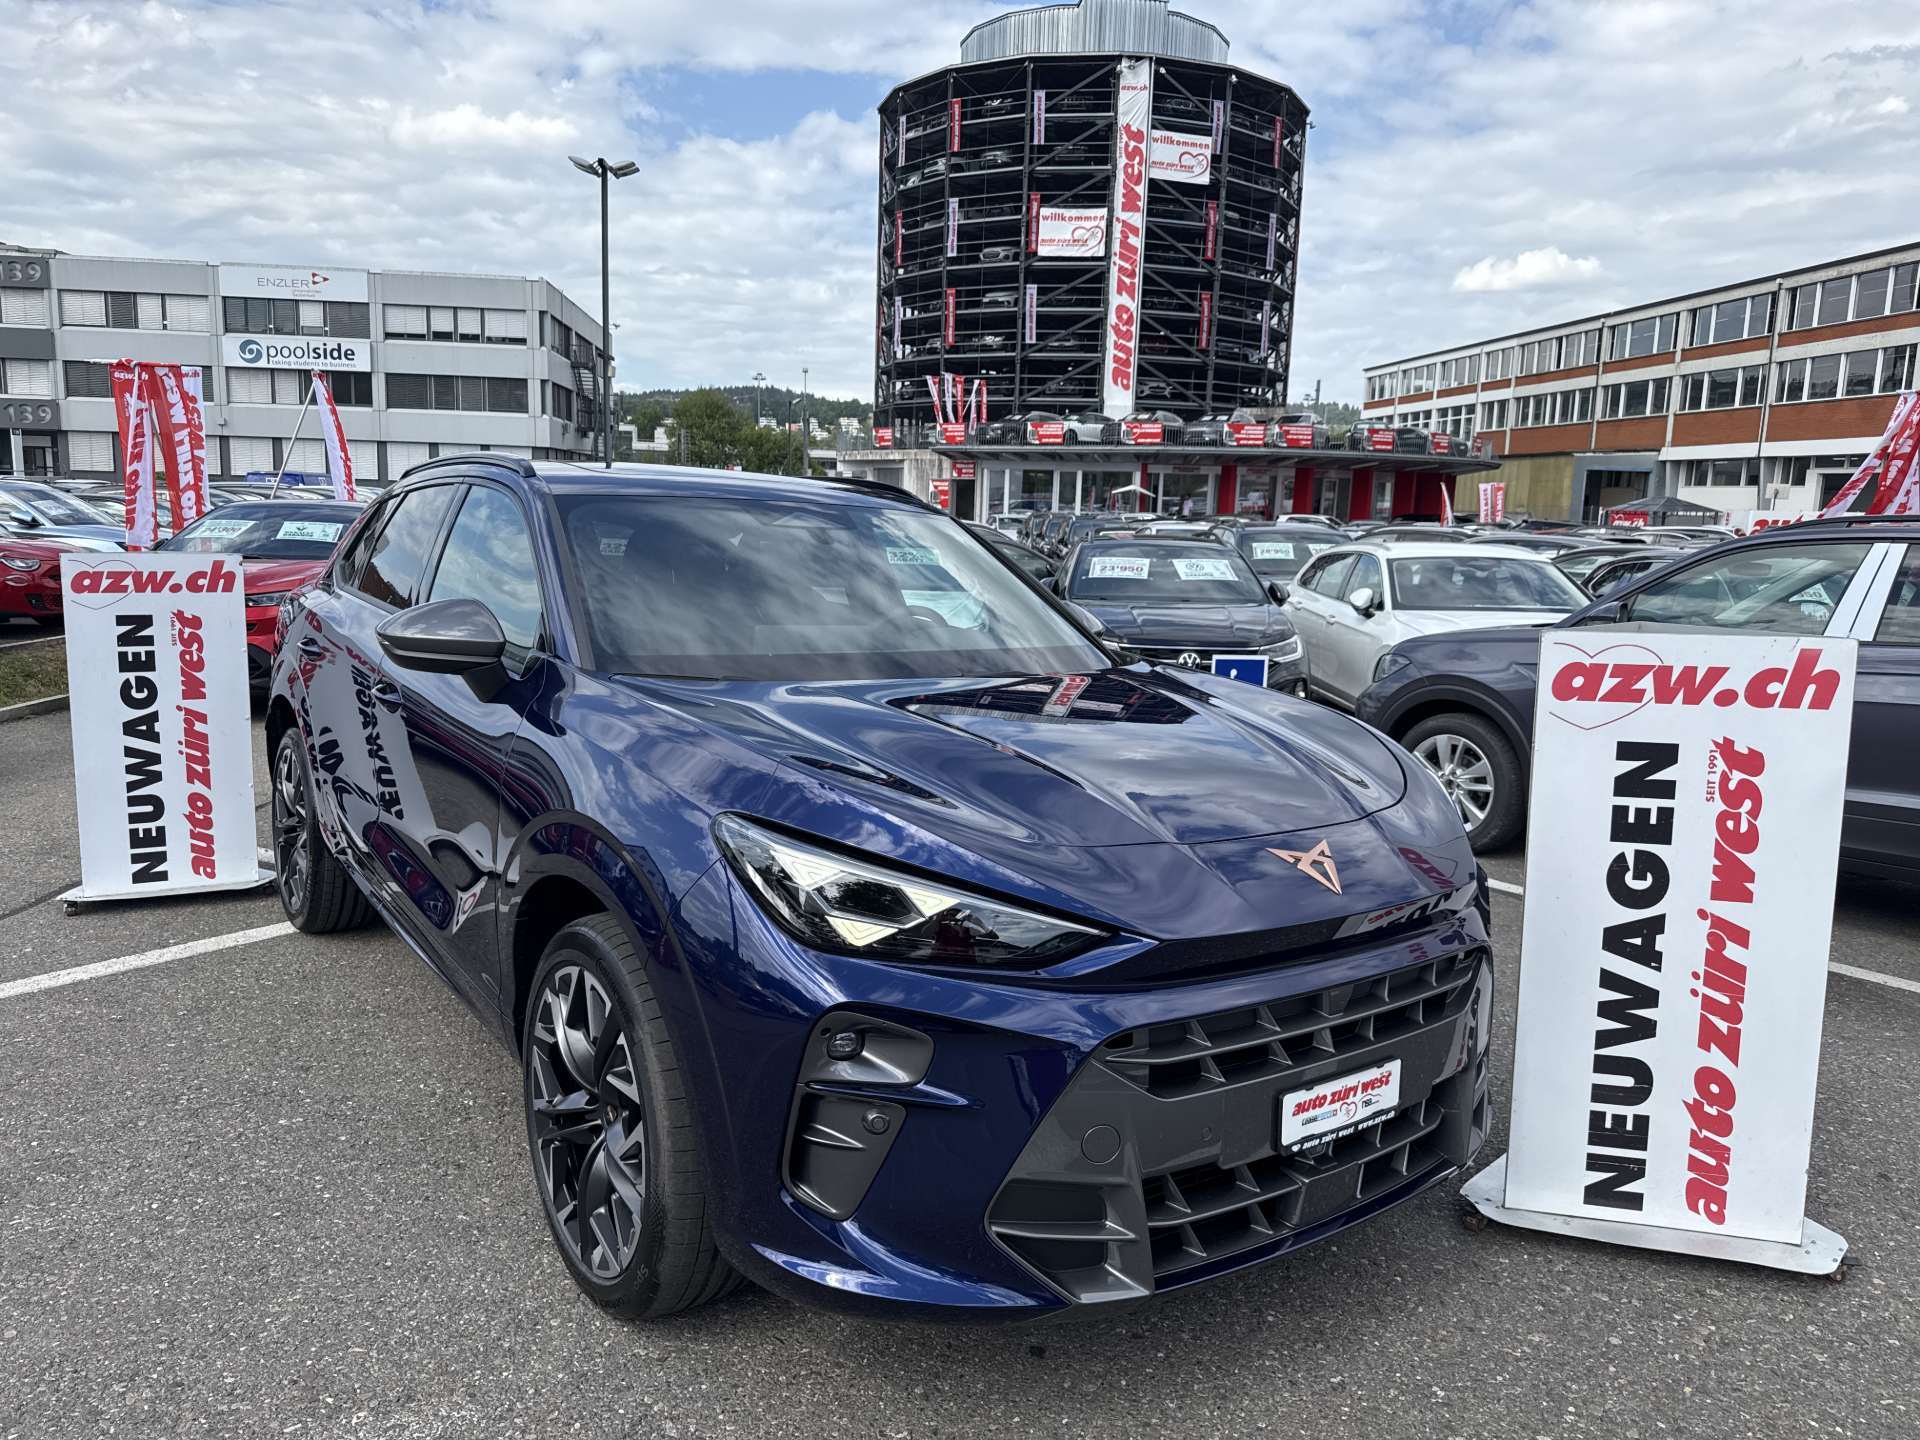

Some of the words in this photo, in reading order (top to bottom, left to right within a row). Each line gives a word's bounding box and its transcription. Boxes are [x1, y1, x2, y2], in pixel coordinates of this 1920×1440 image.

[1121, 123, 1145, 213] west
[1151, 136, 1210, 150] willkommen
[1041, 212, 1105, 223] willkommen
[256, 277, 310, 289] ENZLER
[1112, 217, 1140, 303] züri
[266, 341, 356, 364] poolside
[271, 359, 292, 367] taking
[293, 359, 321, 368] students
[321, 360, 329, 368] to
[329, 361, 357, 369] business
[1111, 304, 1135, 391] auto
[3, 402, 52, 424] 139
[70, 560, 237, 595] azw.ch
[171, 608, 207, 700] west
[1551, 648, 1841, 711] azw.ch
[115, 614, 169, 885] NEUWAGEN
[176, 705, 212, 791] züri
[1707, 748, 1719, 776] 1991
[1705, 779, 1717, 803] SEIT
[1710, 736, 1766, 904] west
[182, 791, 217, 880] auto
[1583, 740, 1679, 1211] NEUWAGEN
[1689, 908, 1751, 1068] züri
[1292, 1093, 1328, 1116] auto
[1328, 1080, 1361, 1105] züri
[1361, 1070, 1392, 1094] west
[1302, 1138, 1320, 1150] auto
[1339, 1125, 1355, 1138] west
[1681, 1065, 1737, 1226] auto
